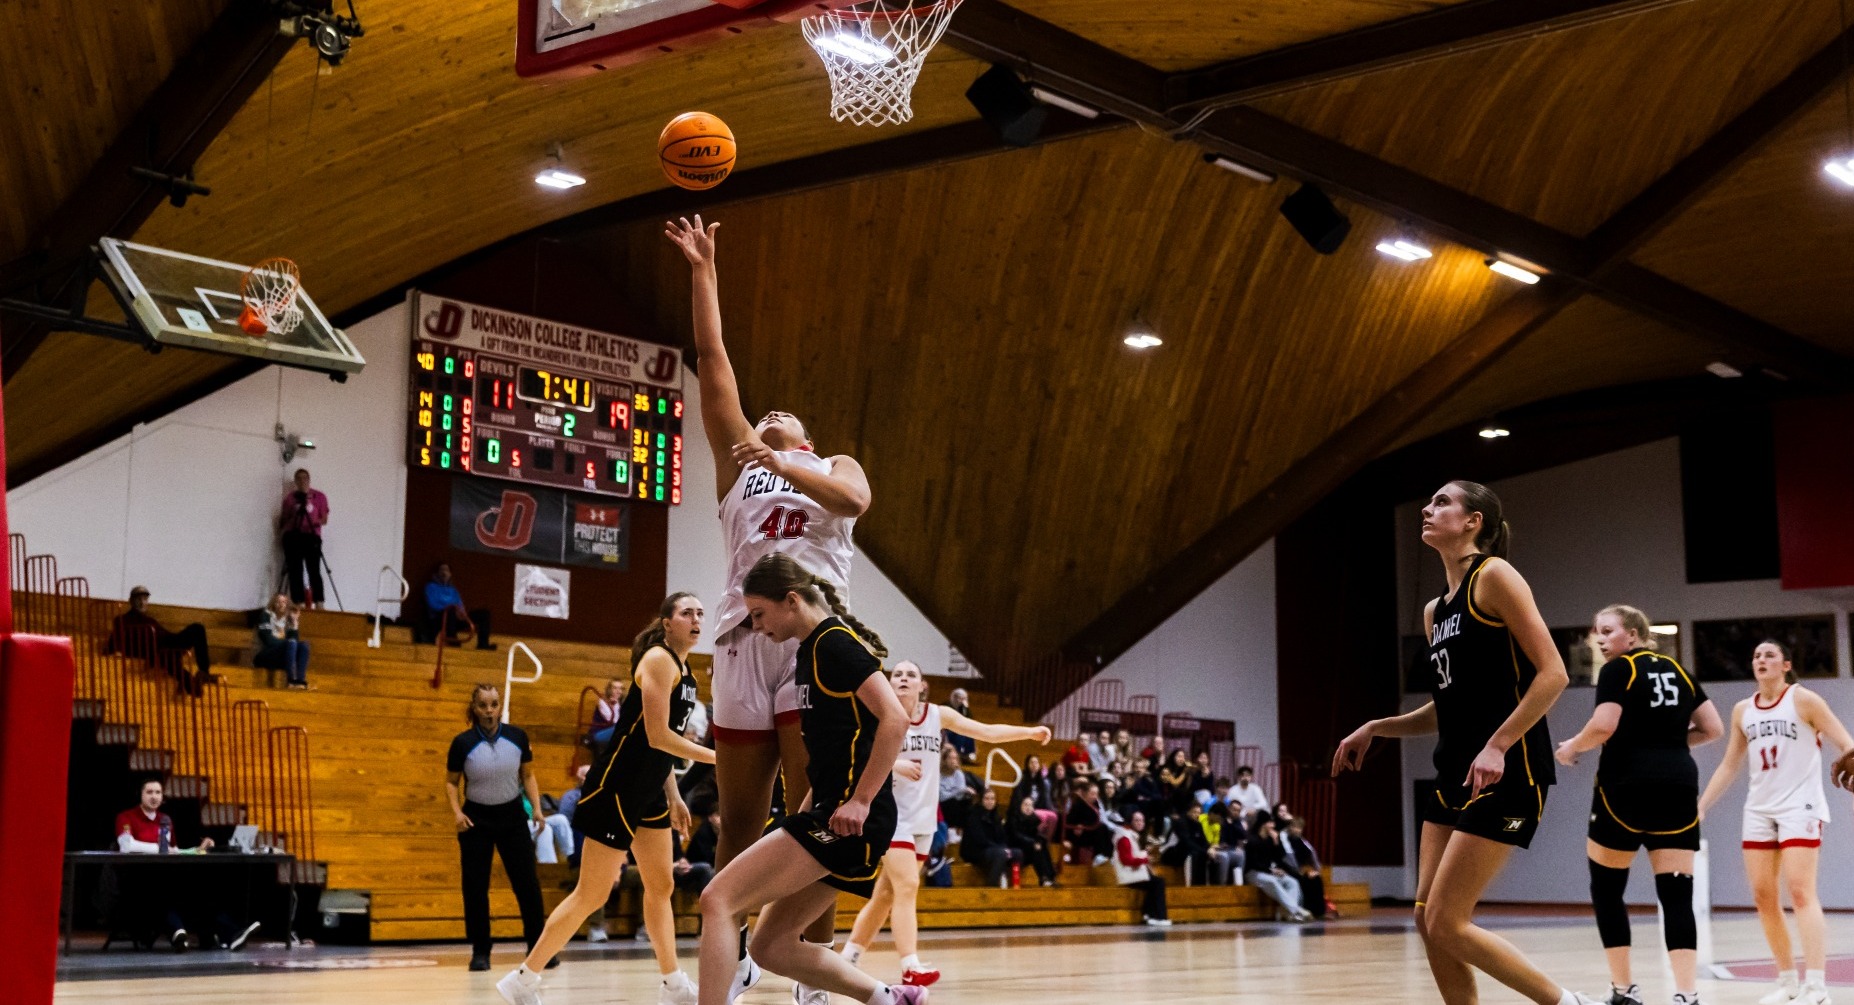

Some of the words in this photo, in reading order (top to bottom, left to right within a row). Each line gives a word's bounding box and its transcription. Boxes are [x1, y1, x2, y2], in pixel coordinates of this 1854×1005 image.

[689, 146, 720, 158] EVO
[678, 168, 728, 184] Wilson
[471, 308, 532, 340] DICKINSON
[535, 322, 582, 352] COLLEGE
[585, 333, 639, 363] ATHLETICS
[417, 353, 434, 370] 40
[445, 357, 454, 374] 0
[464, 361, 474, 377] 0
[480, 360, 514, 378] DEVILS
[493, 379, 514, 410] 11
[537, 371, 590, 406] 7:41
[420, 391, 433, 408] 14
[443, 394, 452, 411] 0
[463, 399, 472, 415] 0
[634, 393, 650, 411] 35
[674, 401, 682, 418] 2
[419, 410, 432, 427] 10
[442, 413, 452, 430] 0
[462, 417, 471, 433] 5
[563, 413, 576, 437] 2
[610, 401, 628, 430] 19
[426, 431, 431, 446] 1
[446, 434, 451, 449] 1
[461, 436, 470, 452] 0
[487, 438, 500, 463] 0
[633, 428, 649, 446] 31
[674, 436, 682, 452] 3
[421, 448, 430, 466] 5
[441, 451, 450, 468] 0
[461, 456, 470, 472] 4
[511, 449, 521, 467] 5
[633, 445, 648, 464] 32
[673, 453, 681, 469] 5
[586, 461, 595, 478] 5
[615, 460, 628, 483] 0
[642, 465, 648, 481] 1
[673, 470, 680, 486] 3
[639, 481, 648, 498] 5
[743, 472, 777, 500] RED
[573, 522, 619, 543] PROTECT
[759, 506, 809, 540] 40
[1432, 613, 1461, 647] DANIEL
[1431, 648, 1452, 689] 32
[1647, 672, 1679, 708] 35
[1760, 719, 1797, 740] DEVILS
[911, 735, 939, 753] DEVILS
